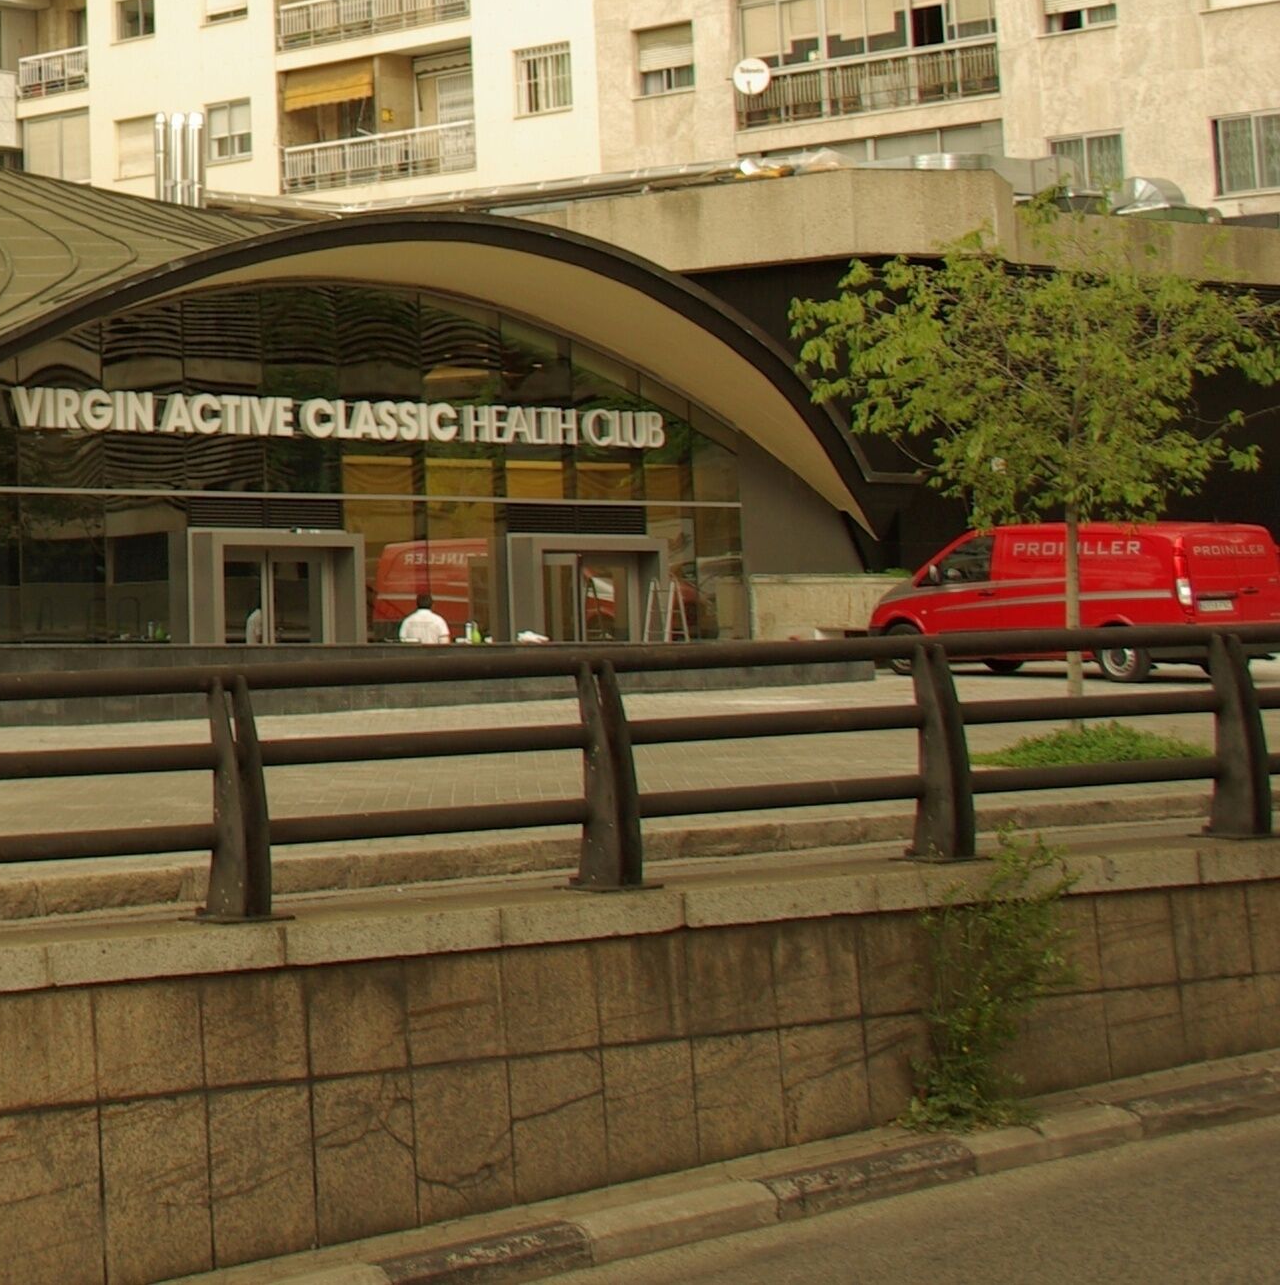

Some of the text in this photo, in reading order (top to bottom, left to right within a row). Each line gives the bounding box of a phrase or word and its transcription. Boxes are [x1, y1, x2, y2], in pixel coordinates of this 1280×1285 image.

[11, 386, 665, 448] VIRGIN ACTIVE CLASSIC HEALTH CLUB
[1013, 541, 1141, 556] PROILLER
[1193, 544, 1265, 556] PROINLLER
